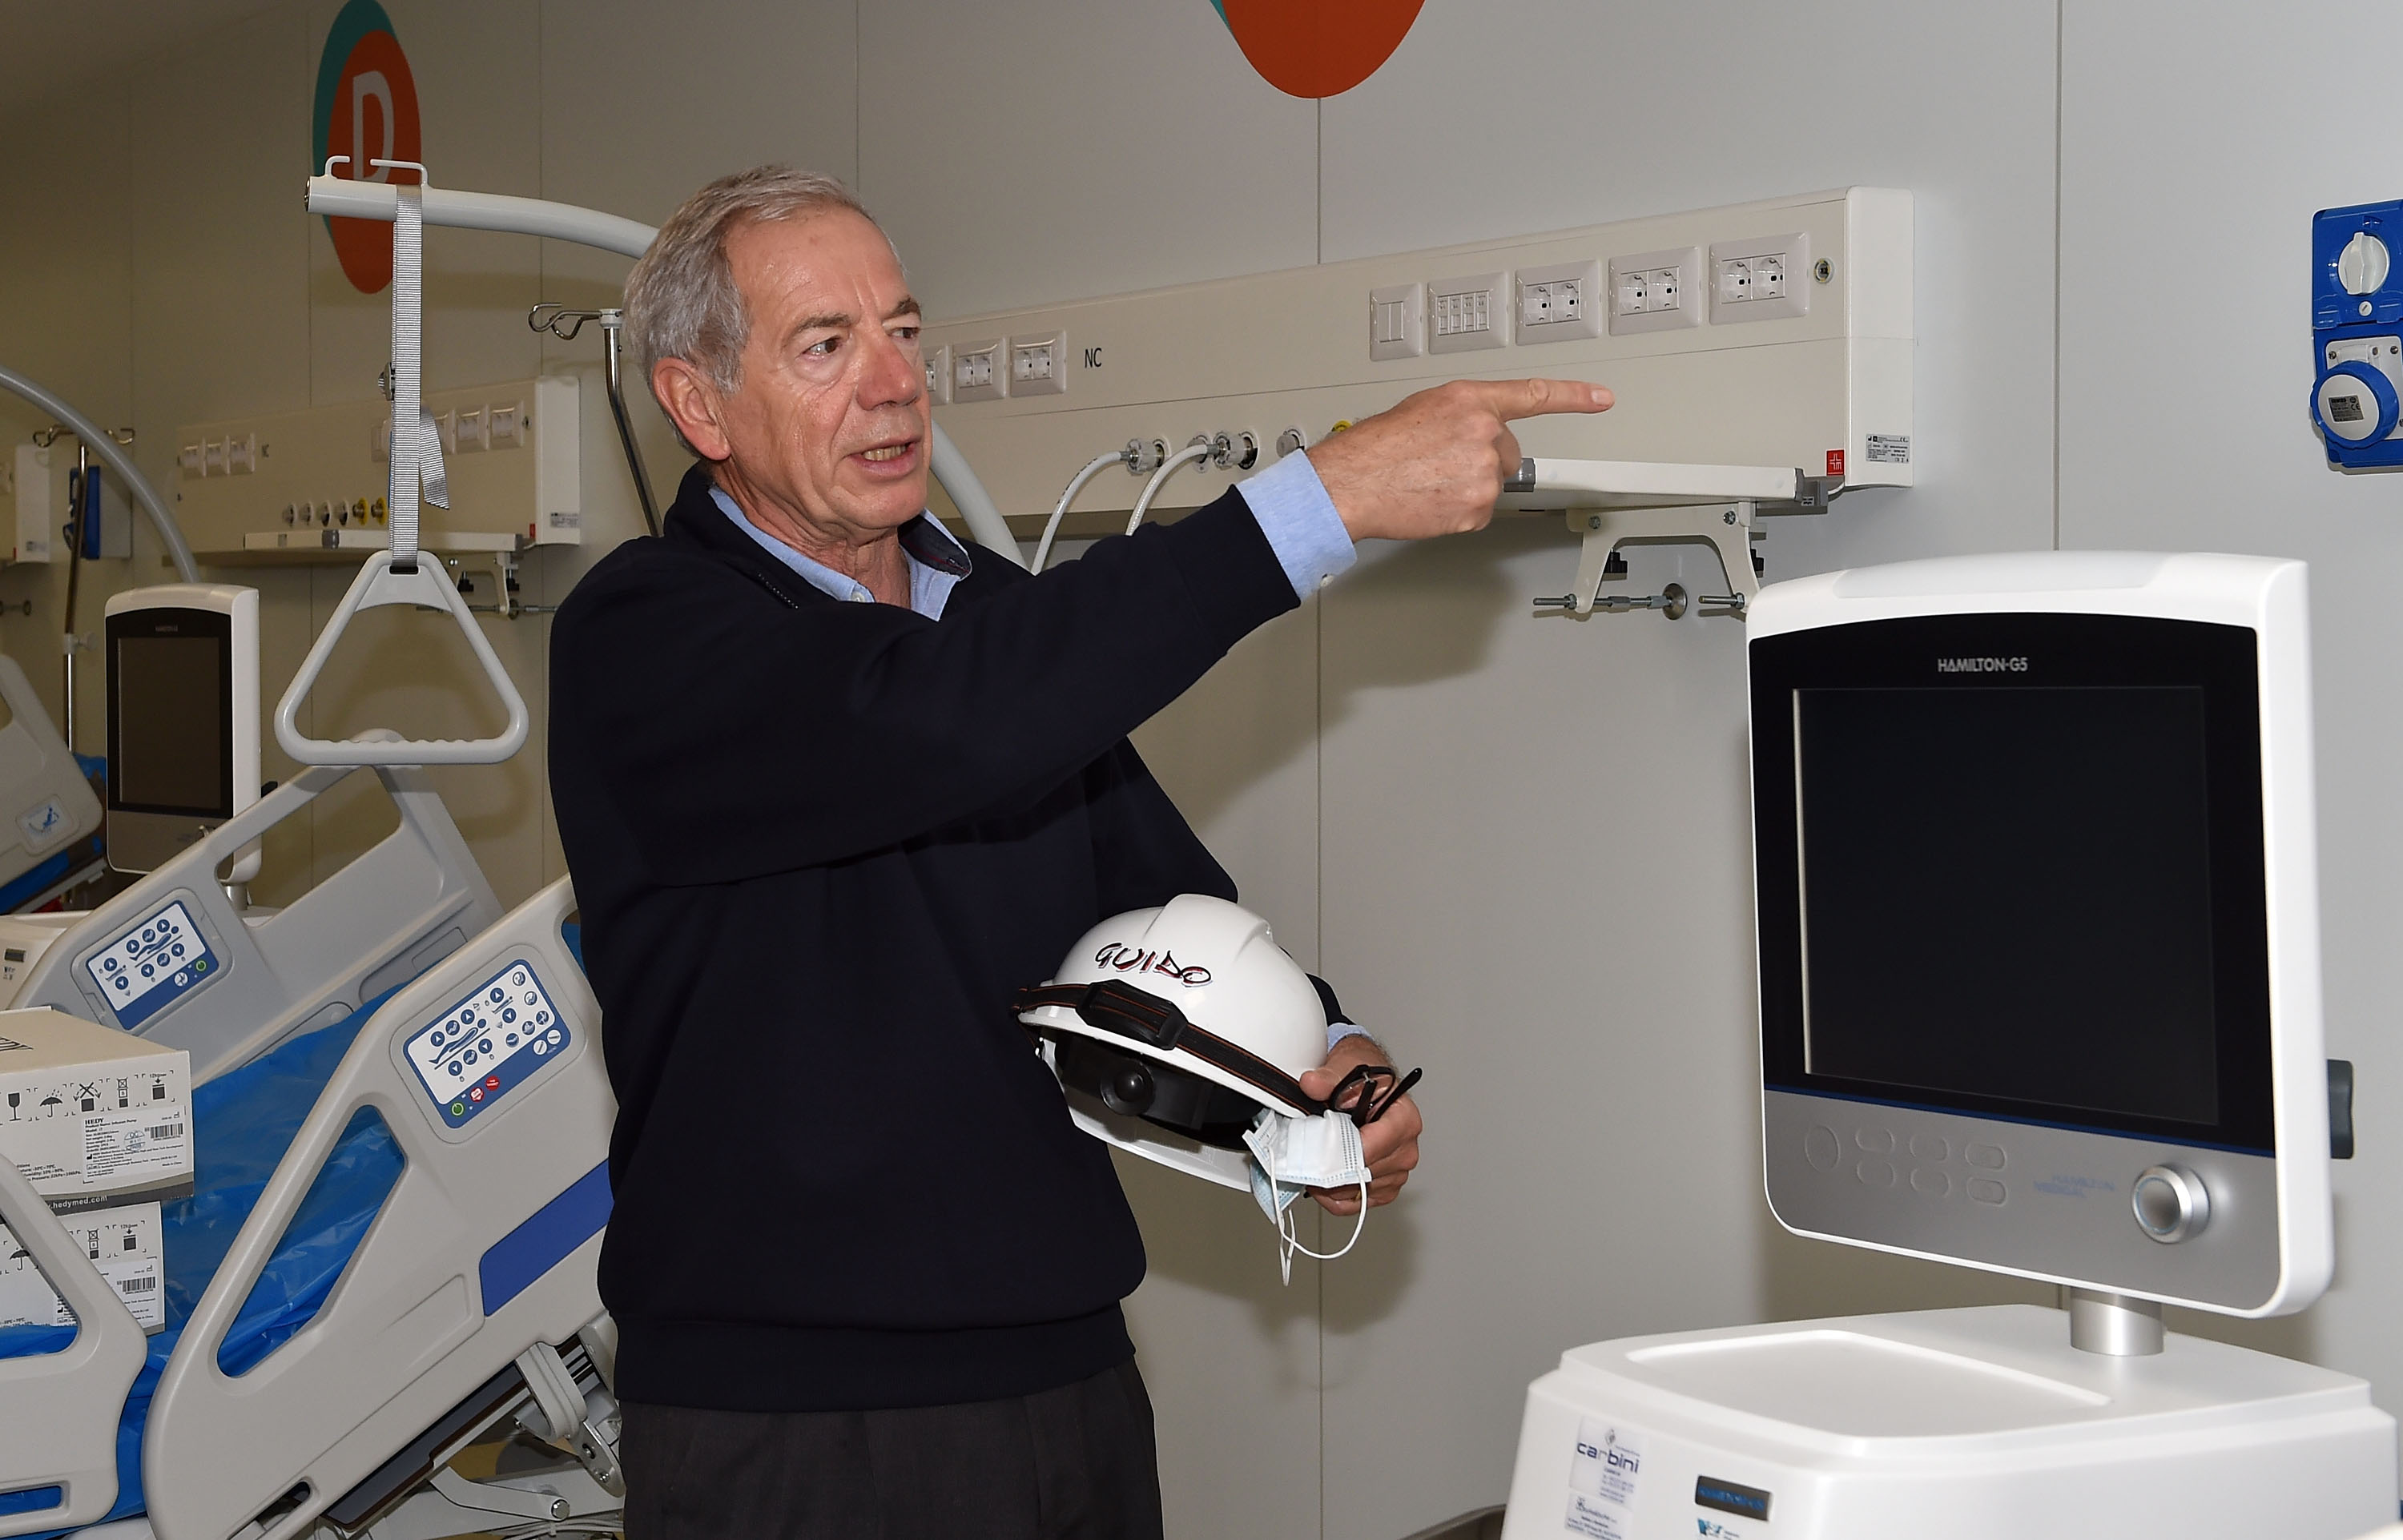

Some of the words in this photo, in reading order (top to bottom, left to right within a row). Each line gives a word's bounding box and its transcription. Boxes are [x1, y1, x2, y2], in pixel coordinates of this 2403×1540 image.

[353, 70, 394, 184] D
[1085, 348, 1102, 368] NC
[1938, 657, 2028, 673] HAMILTON-G5
[1094, 942, 1213, 987] GUIDO
[85, 1117, 104, 1125] HEDY
[1576, 1442, 1640, 1474] carbini
